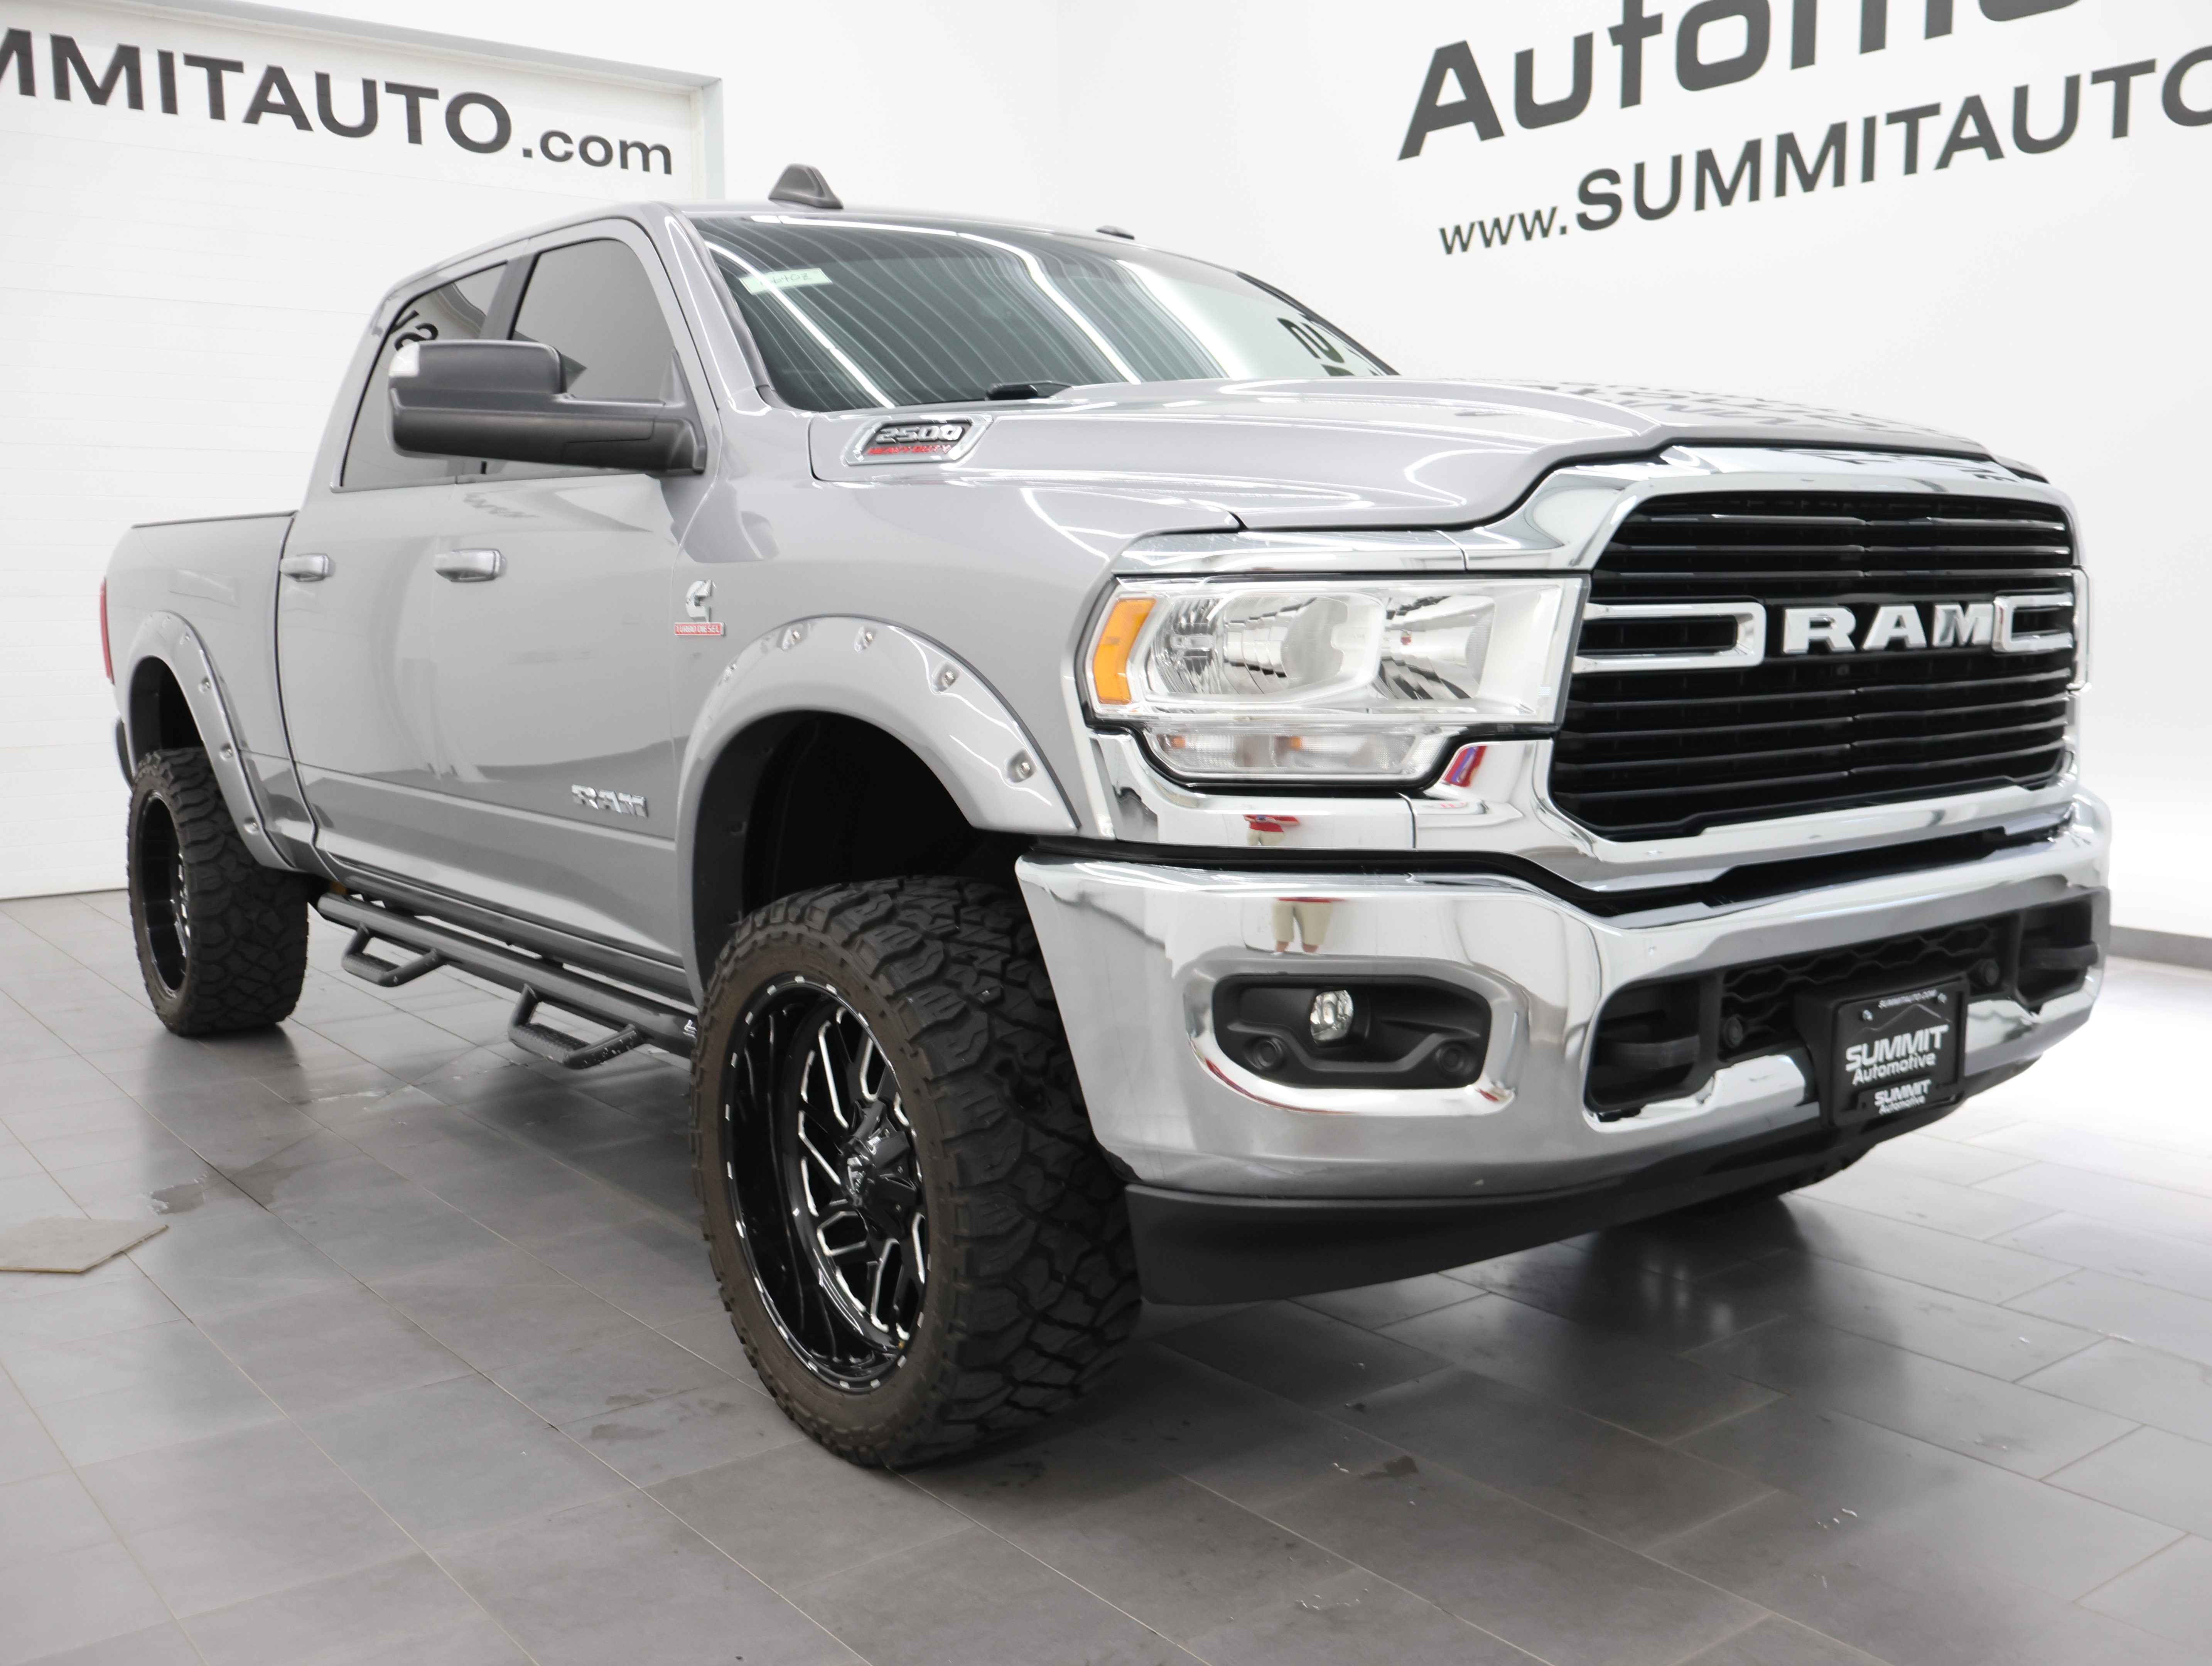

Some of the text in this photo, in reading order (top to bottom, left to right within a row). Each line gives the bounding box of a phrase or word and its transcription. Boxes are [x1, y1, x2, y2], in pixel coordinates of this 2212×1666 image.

[867, 444, 952, 455] HEAVY DUTY
[876, 425, 963, 443] 2500
[1783, 602, 1994, 654] RAM
[571, 784, 649, 818] RAM
[1845, 1024, 1950, 1072] SUMMIT
[1852, 1052, 1936, 1086] Automotive
[1874, 1079, 1932, 1108] SUMMIT
[1878, 1095, 1925, 1116] Automotive
